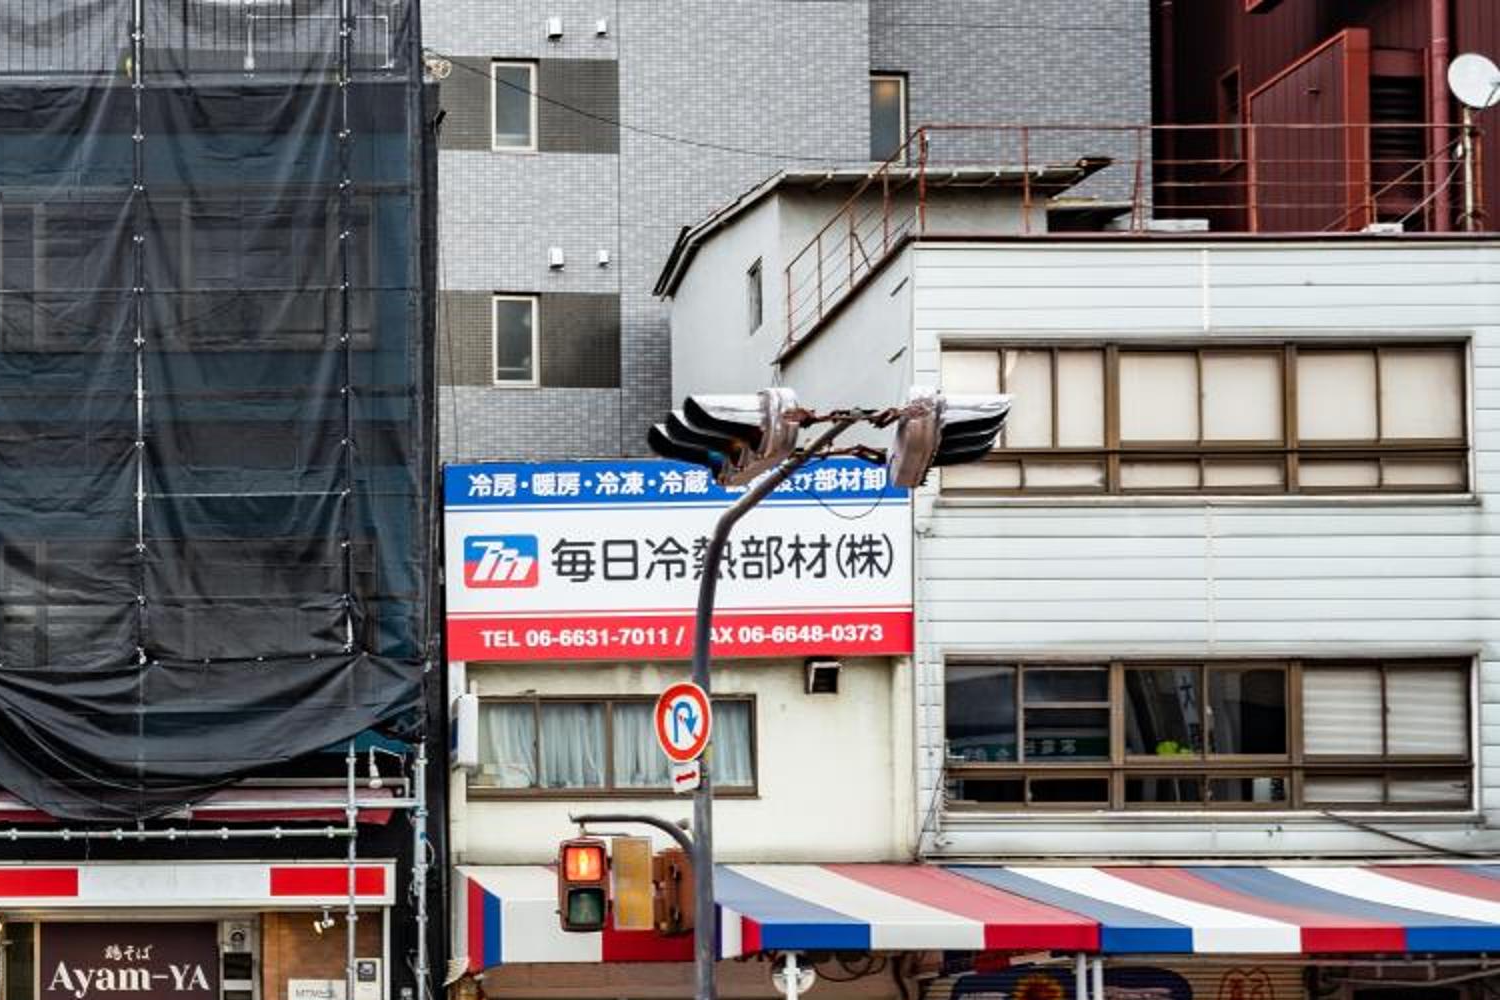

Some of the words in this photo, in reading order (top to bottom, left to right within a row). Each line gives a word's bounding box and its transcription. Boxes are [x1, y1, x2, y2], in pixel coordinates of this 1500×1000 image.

[467, 467, 887, 497] 冷房・暖房・冷凍・冷蔵・及び部材卸
[480, 630, 520, 648] TEL
[525, 627, 669, 647] 06-6631-7011
[737, 623, 884, 643] 06-6648-0373
[47, 961, 211, 999] Ayam-YA
